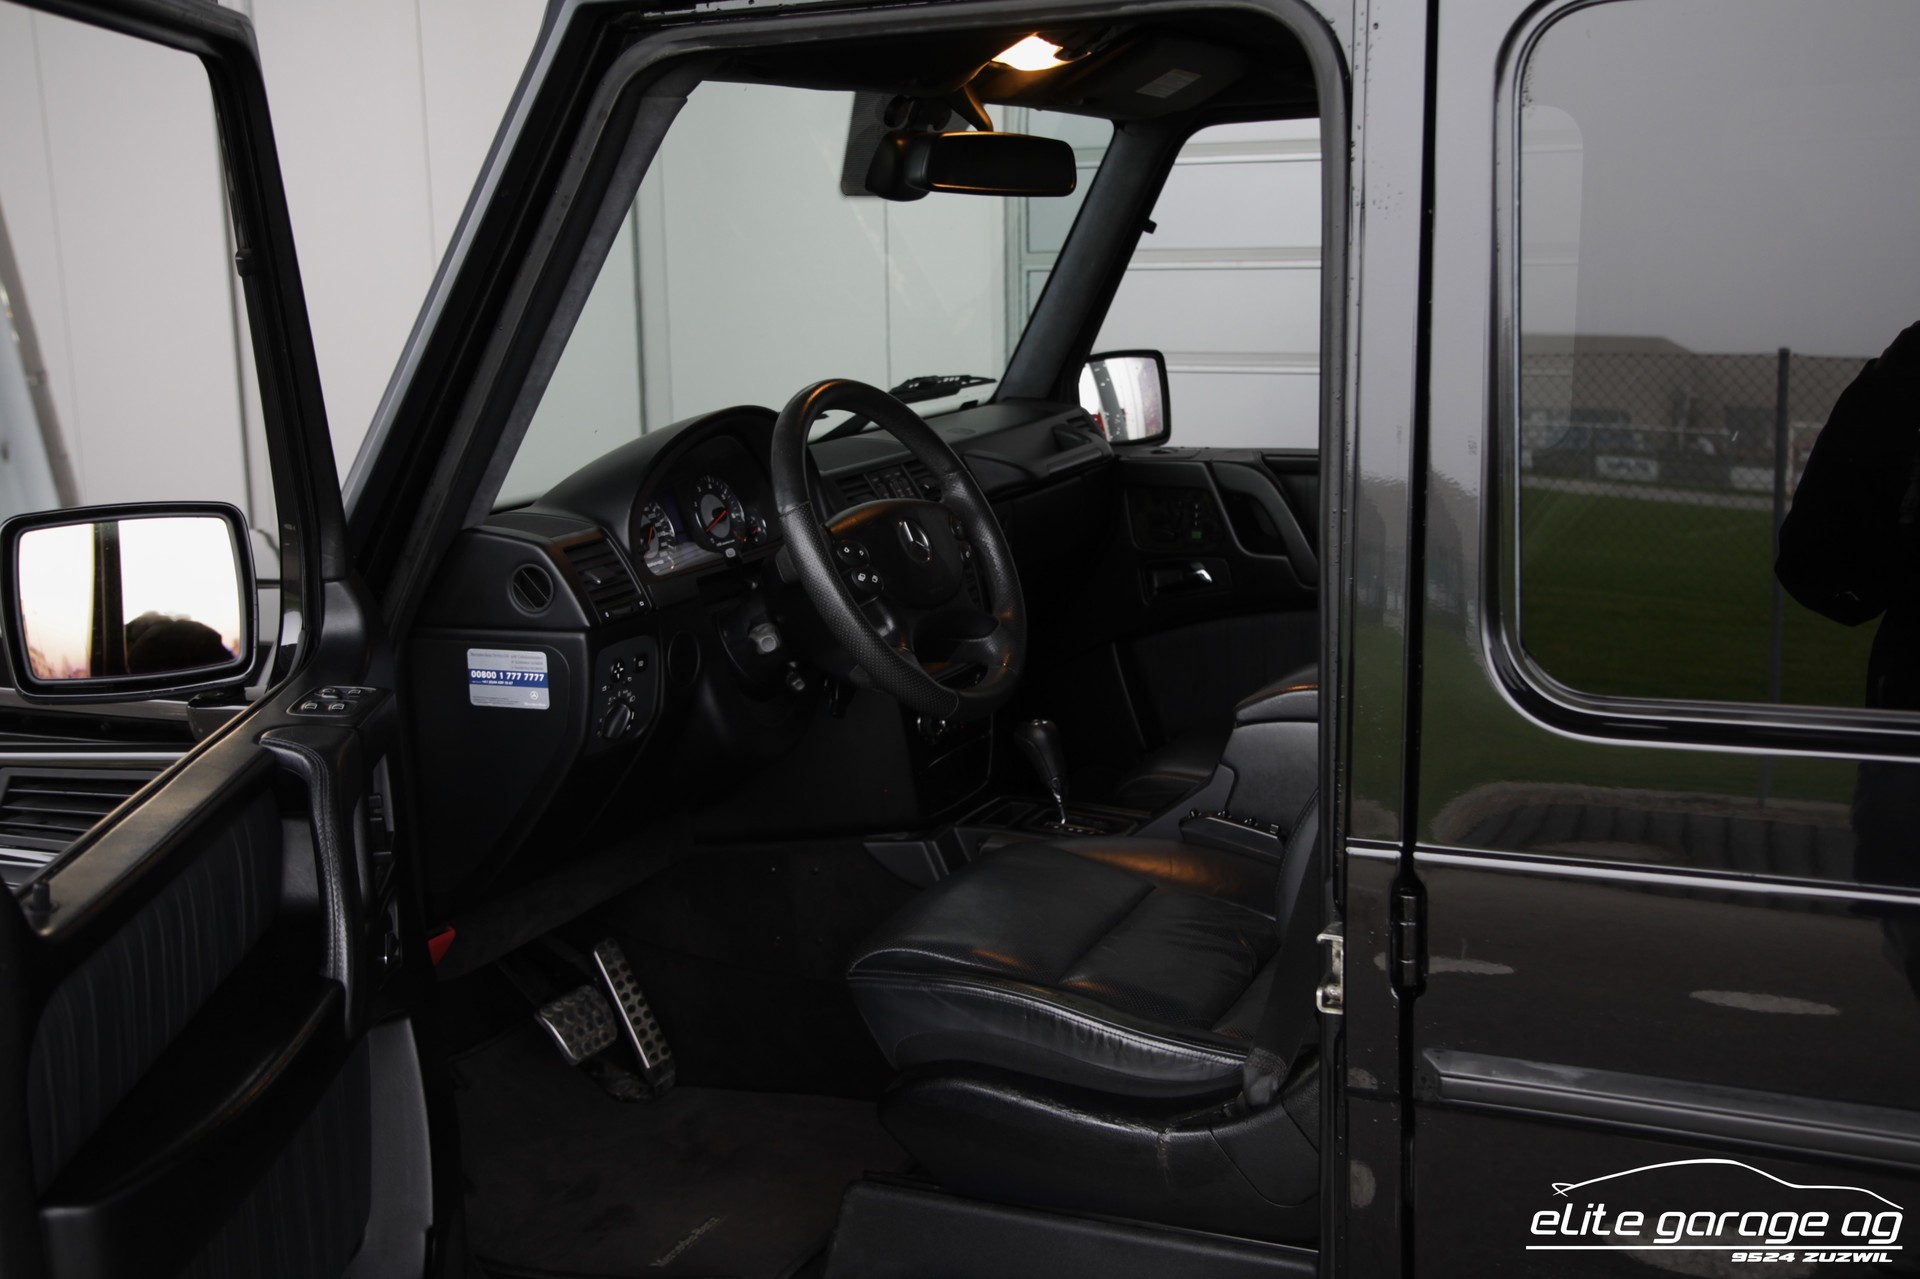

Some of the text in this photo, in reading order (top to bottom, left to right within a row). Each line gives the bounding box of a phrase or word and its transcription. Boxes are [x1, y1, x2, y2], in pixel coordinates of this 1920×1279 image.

[471, 670, 545, 682] 00800 1 777 7777
